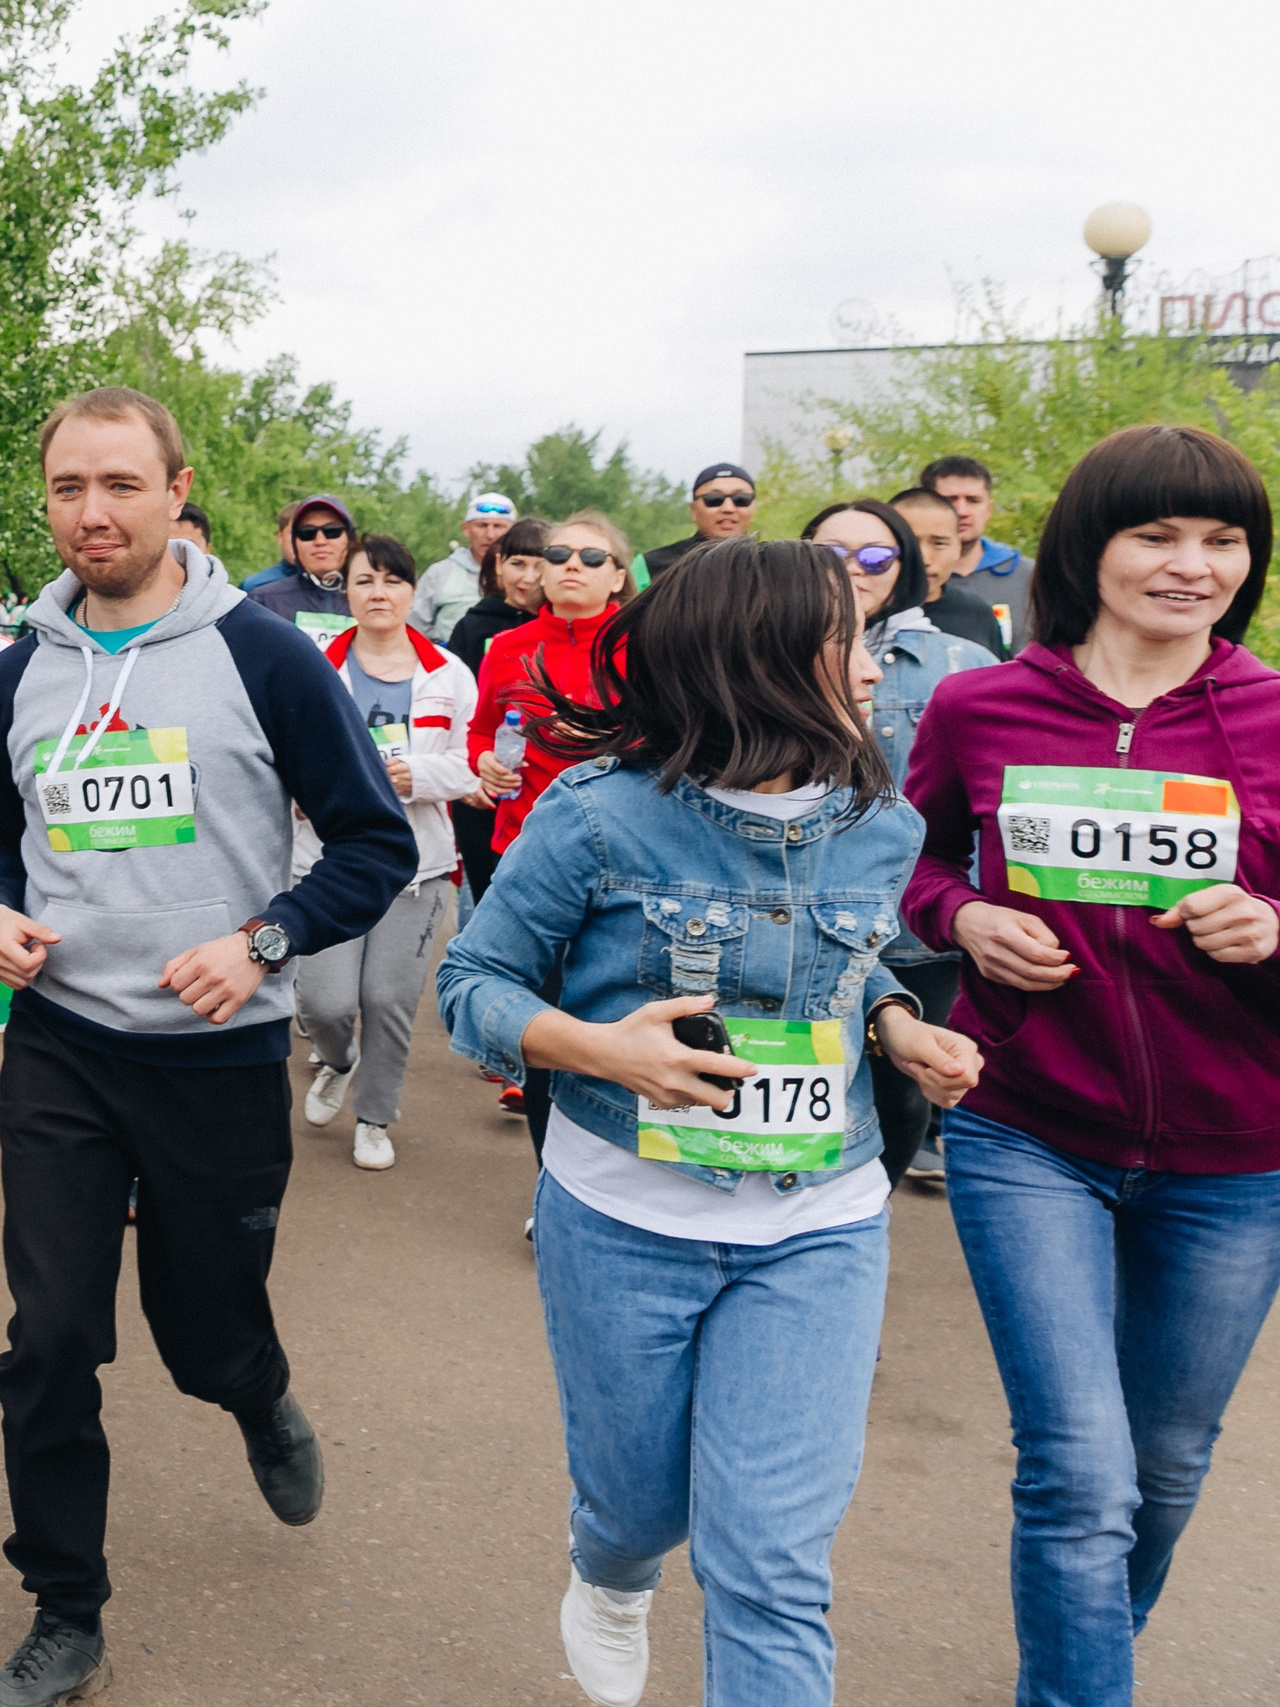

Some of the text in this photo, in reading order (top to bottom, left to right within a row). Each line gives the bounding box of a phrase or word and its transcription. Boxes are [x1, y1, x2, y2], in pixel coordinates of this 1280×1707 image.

[82, 773, 173, 813] 0701
[89, 824, 136, 838] бежим
[1071, 818, 1217, 869] 0158
[1077, 873, 1149, 891] бежим
[718, 1136, 783, 1155] бежим
